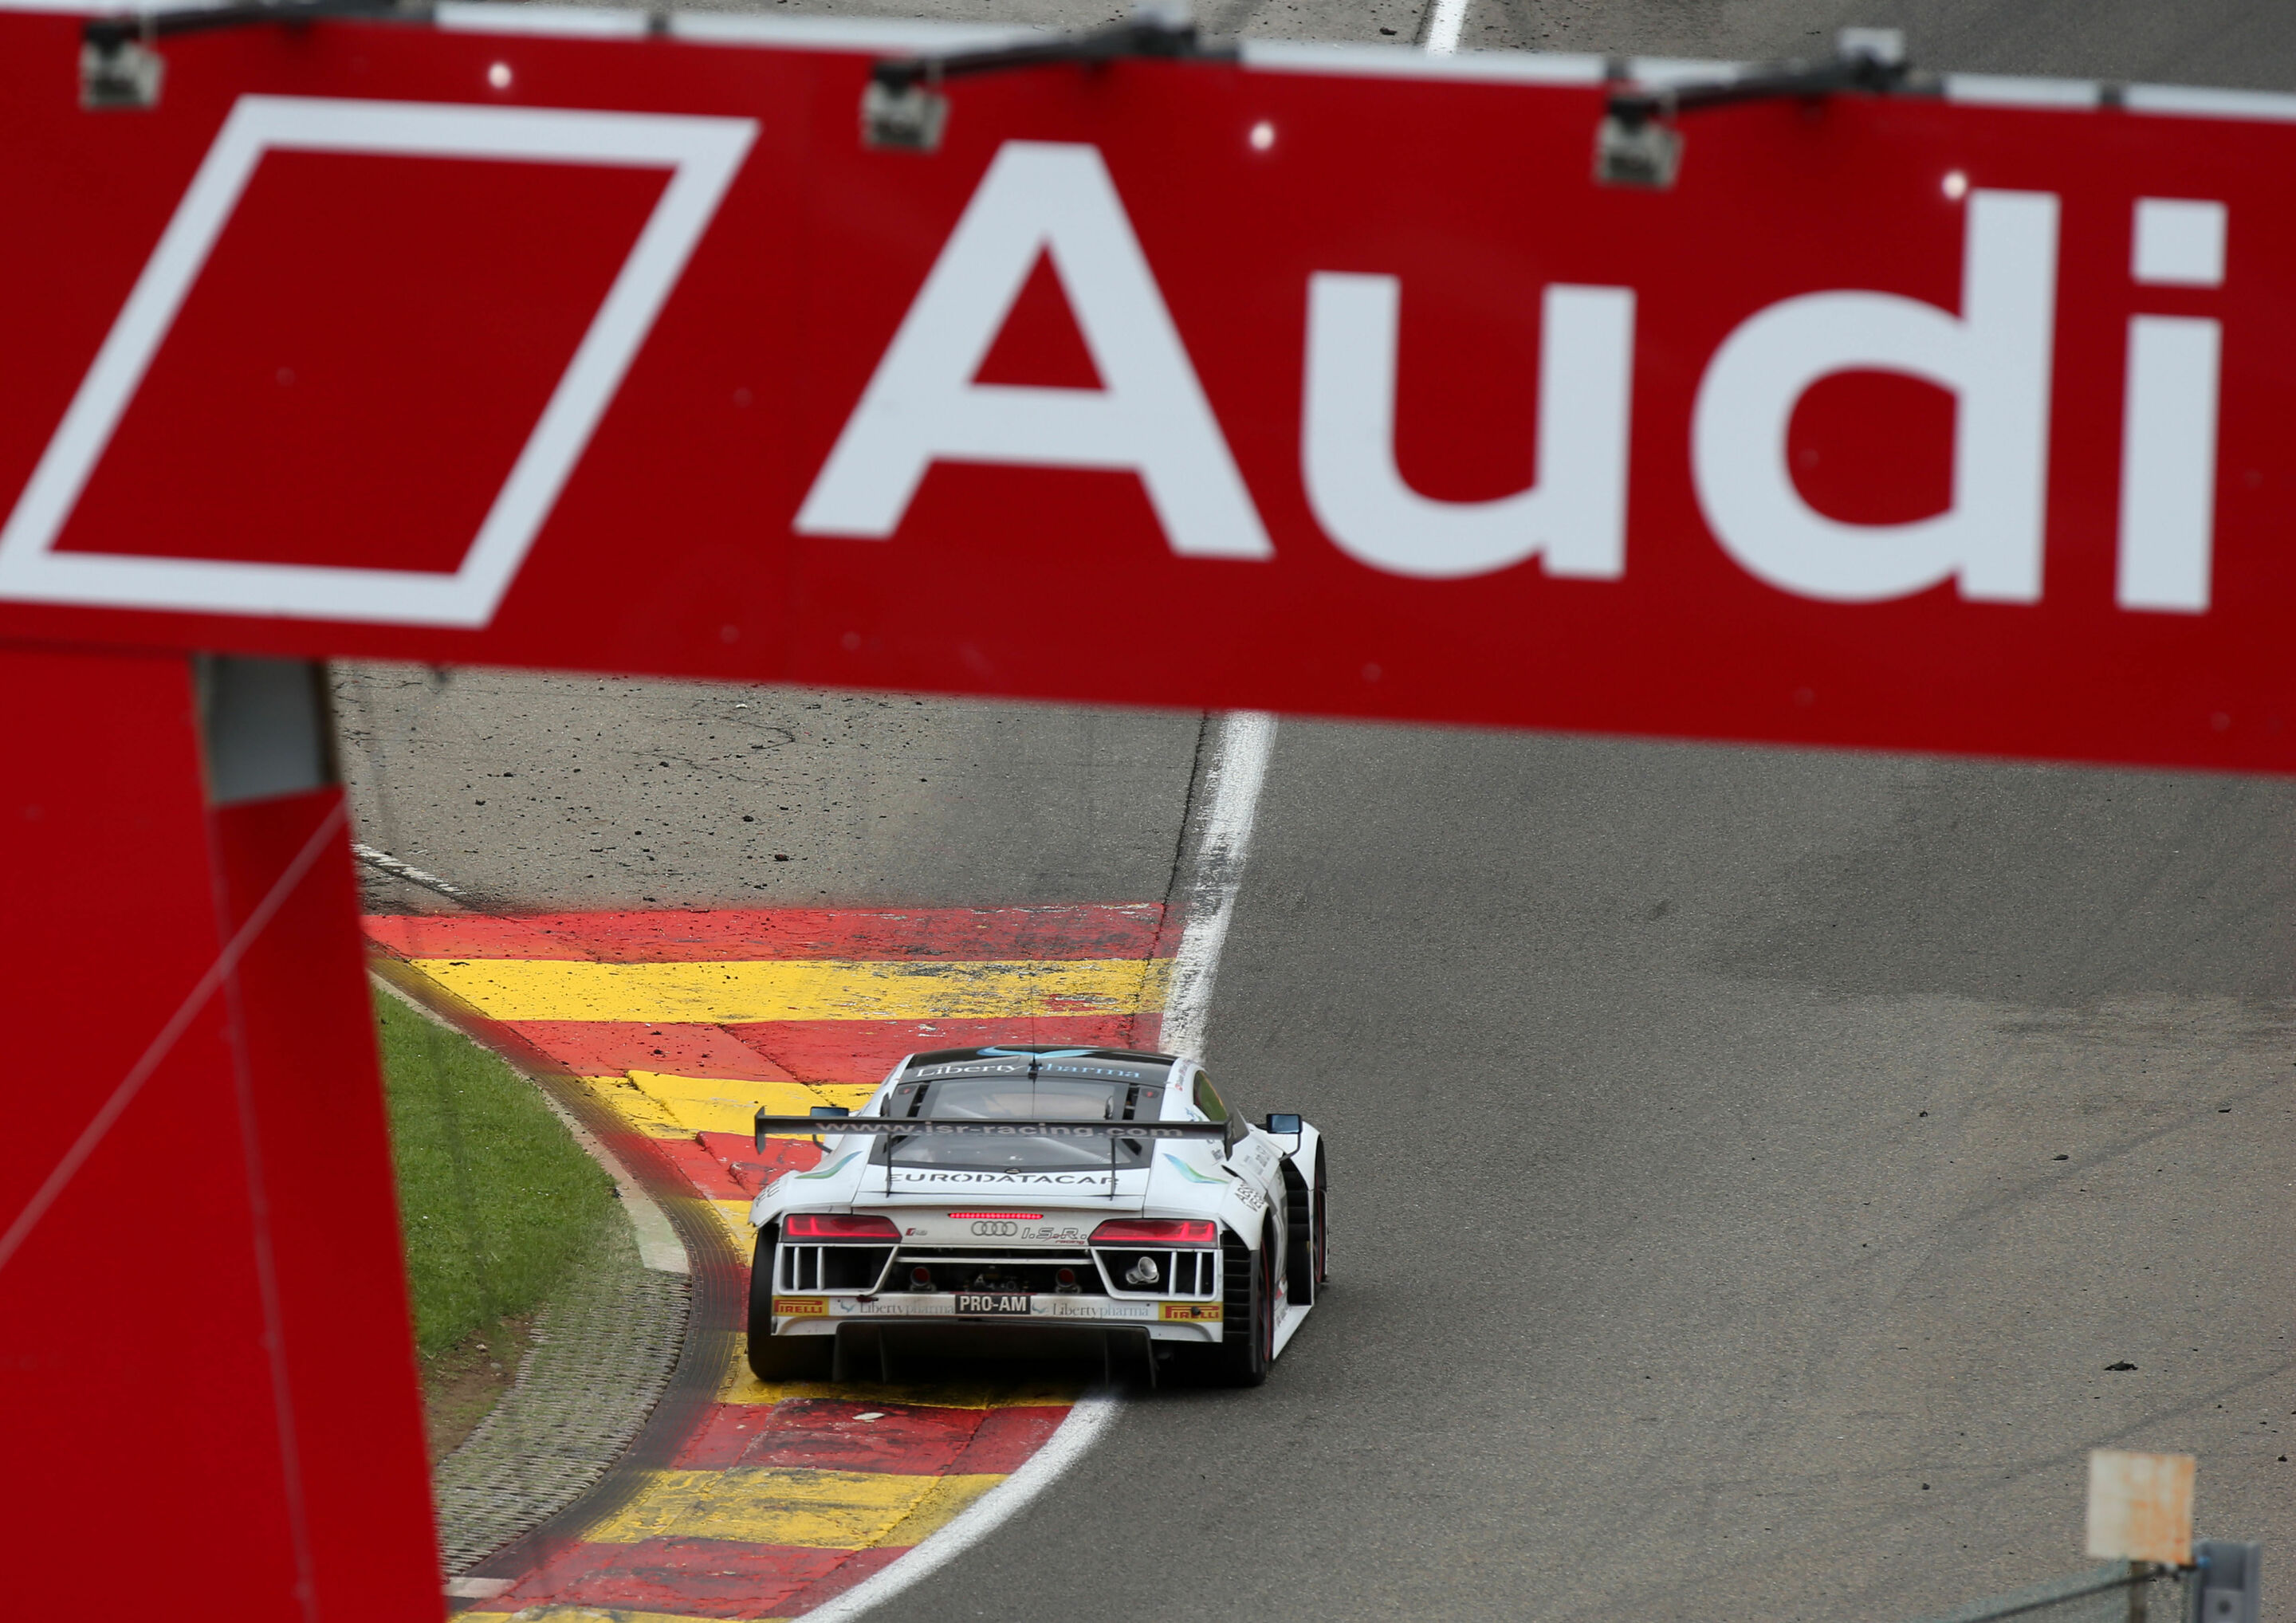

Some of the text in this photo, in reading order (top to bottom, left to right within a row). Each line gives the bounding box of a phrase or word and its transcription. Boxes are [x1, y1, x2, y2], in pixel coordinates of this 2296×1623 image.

[792, 140, 2227, 613] Audi
[816, 1121, 1184, 1138] www.isr-racing.com
[885, 1173, 1119, 1185] EURODATACAR
[774, 1299, 824, 1314] PIRELLI
[960, 1295, 1027, 1312] PRO-AM
[1165, 1306, 1219, 1319] PIRELLI
